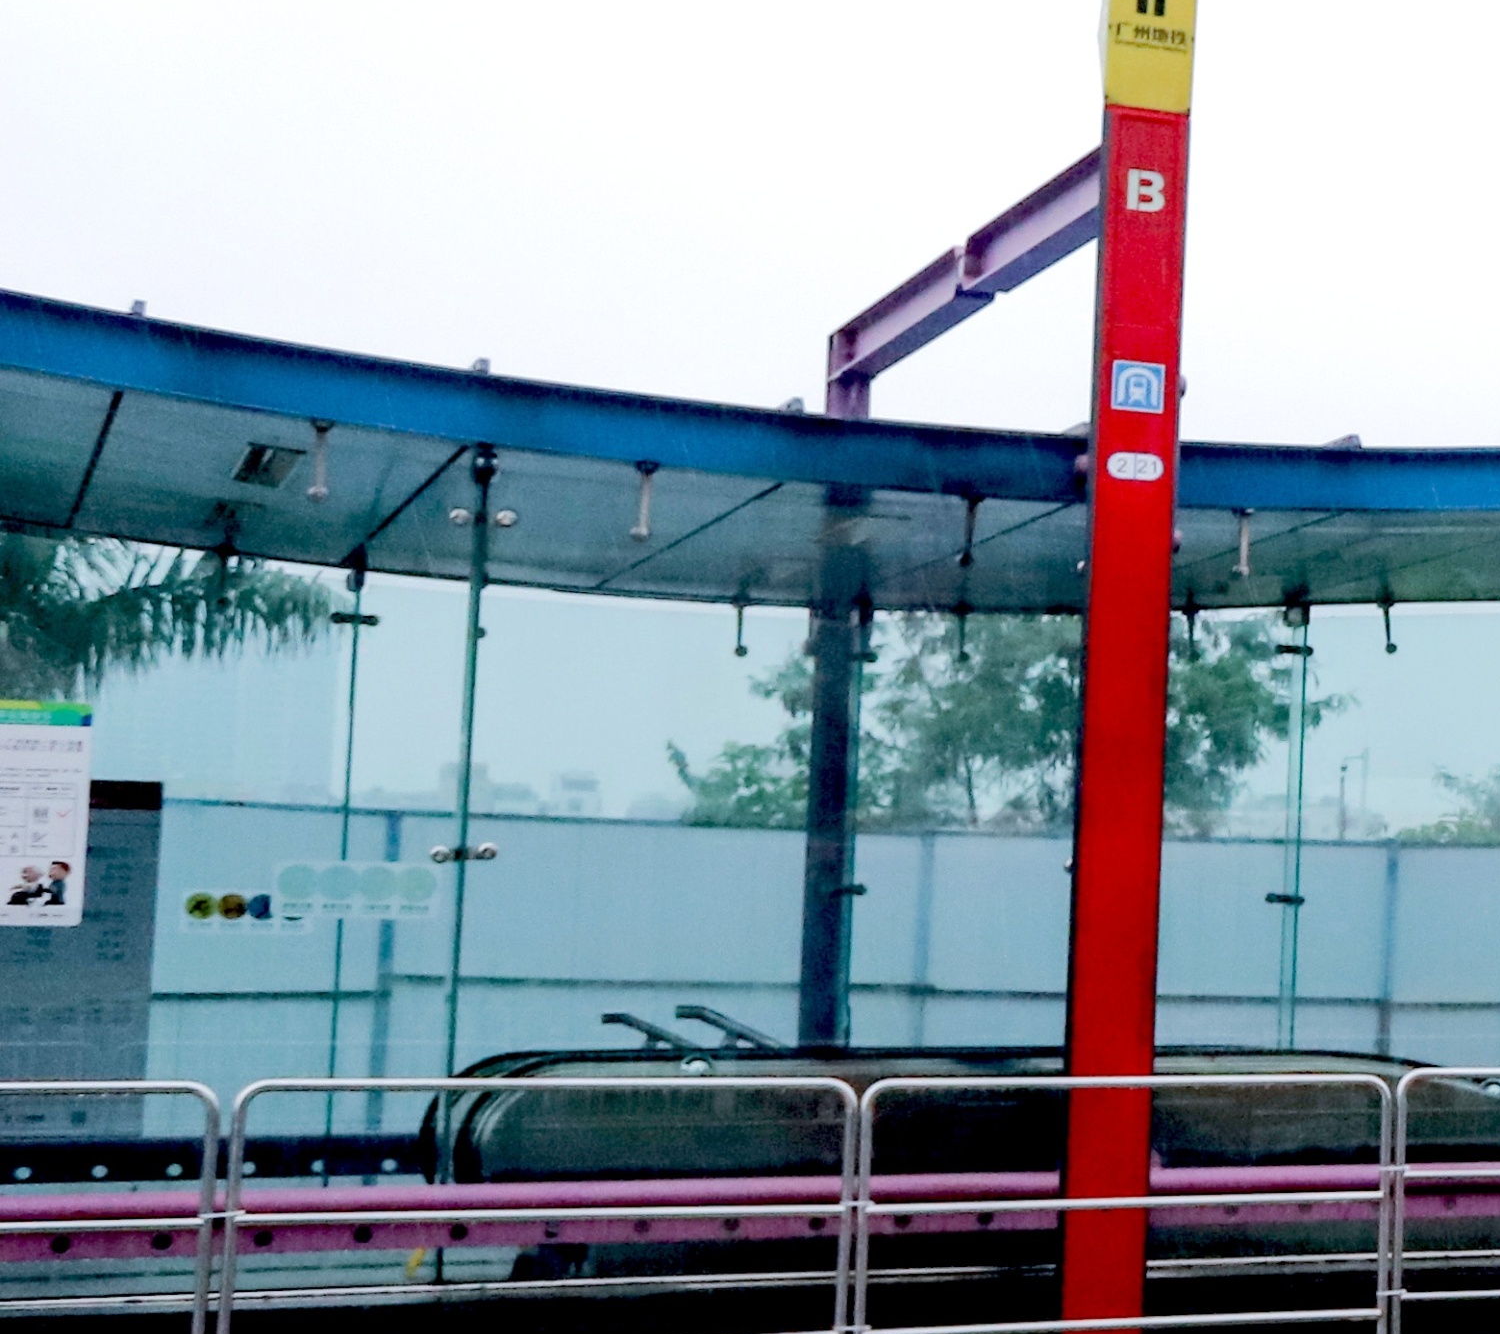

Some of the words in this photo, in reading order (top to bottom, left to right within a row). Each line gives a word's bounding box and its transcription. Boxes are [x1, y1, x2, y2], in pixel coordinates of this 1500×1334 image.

[1126, 168, 1165, 213] B
[1116, 457, 1129, 474] 2
[1137, 458, 1158, 475] 21
